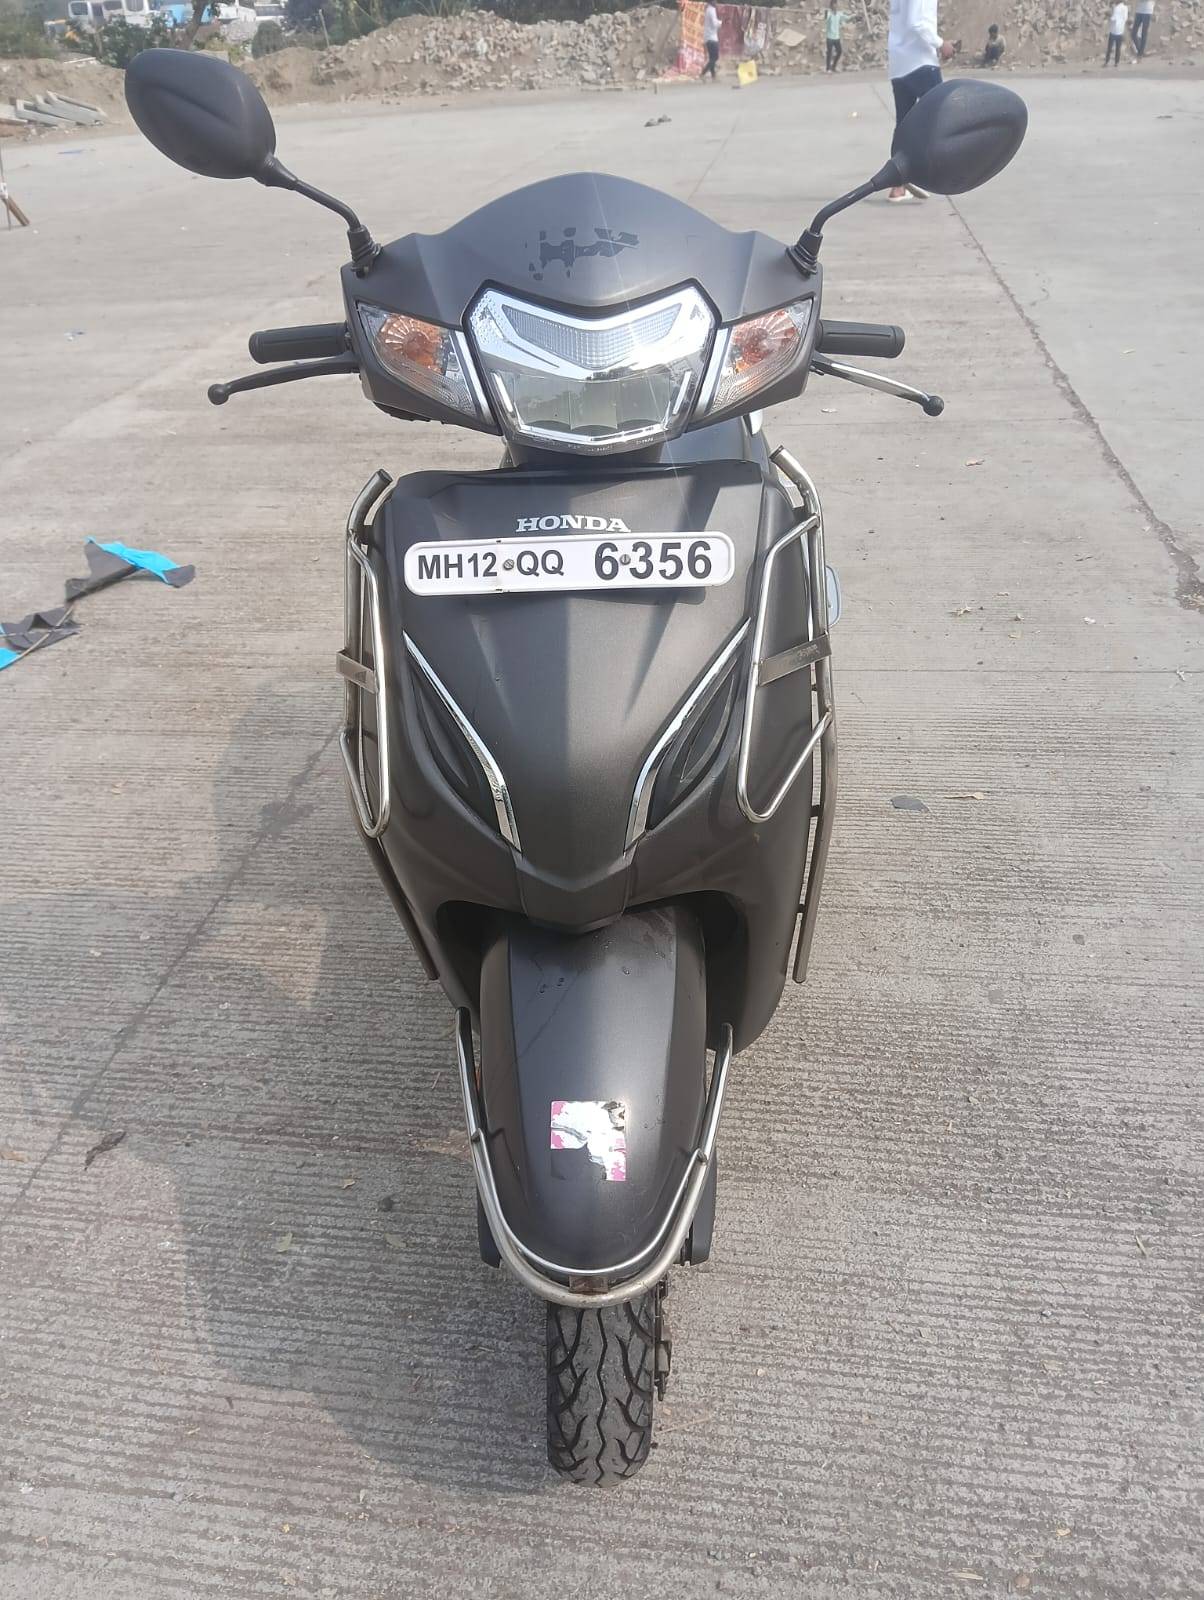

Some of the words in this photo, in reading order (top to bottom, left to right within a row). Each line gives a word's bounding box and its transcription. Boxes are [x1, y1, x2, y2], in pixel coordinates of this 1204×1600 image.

[516, 514, 632, 533] HONDA
[417, 552, 498, 580] MH12
[516, 550, 564, 577] QQ
[594, 540, 712, 581] 6356
